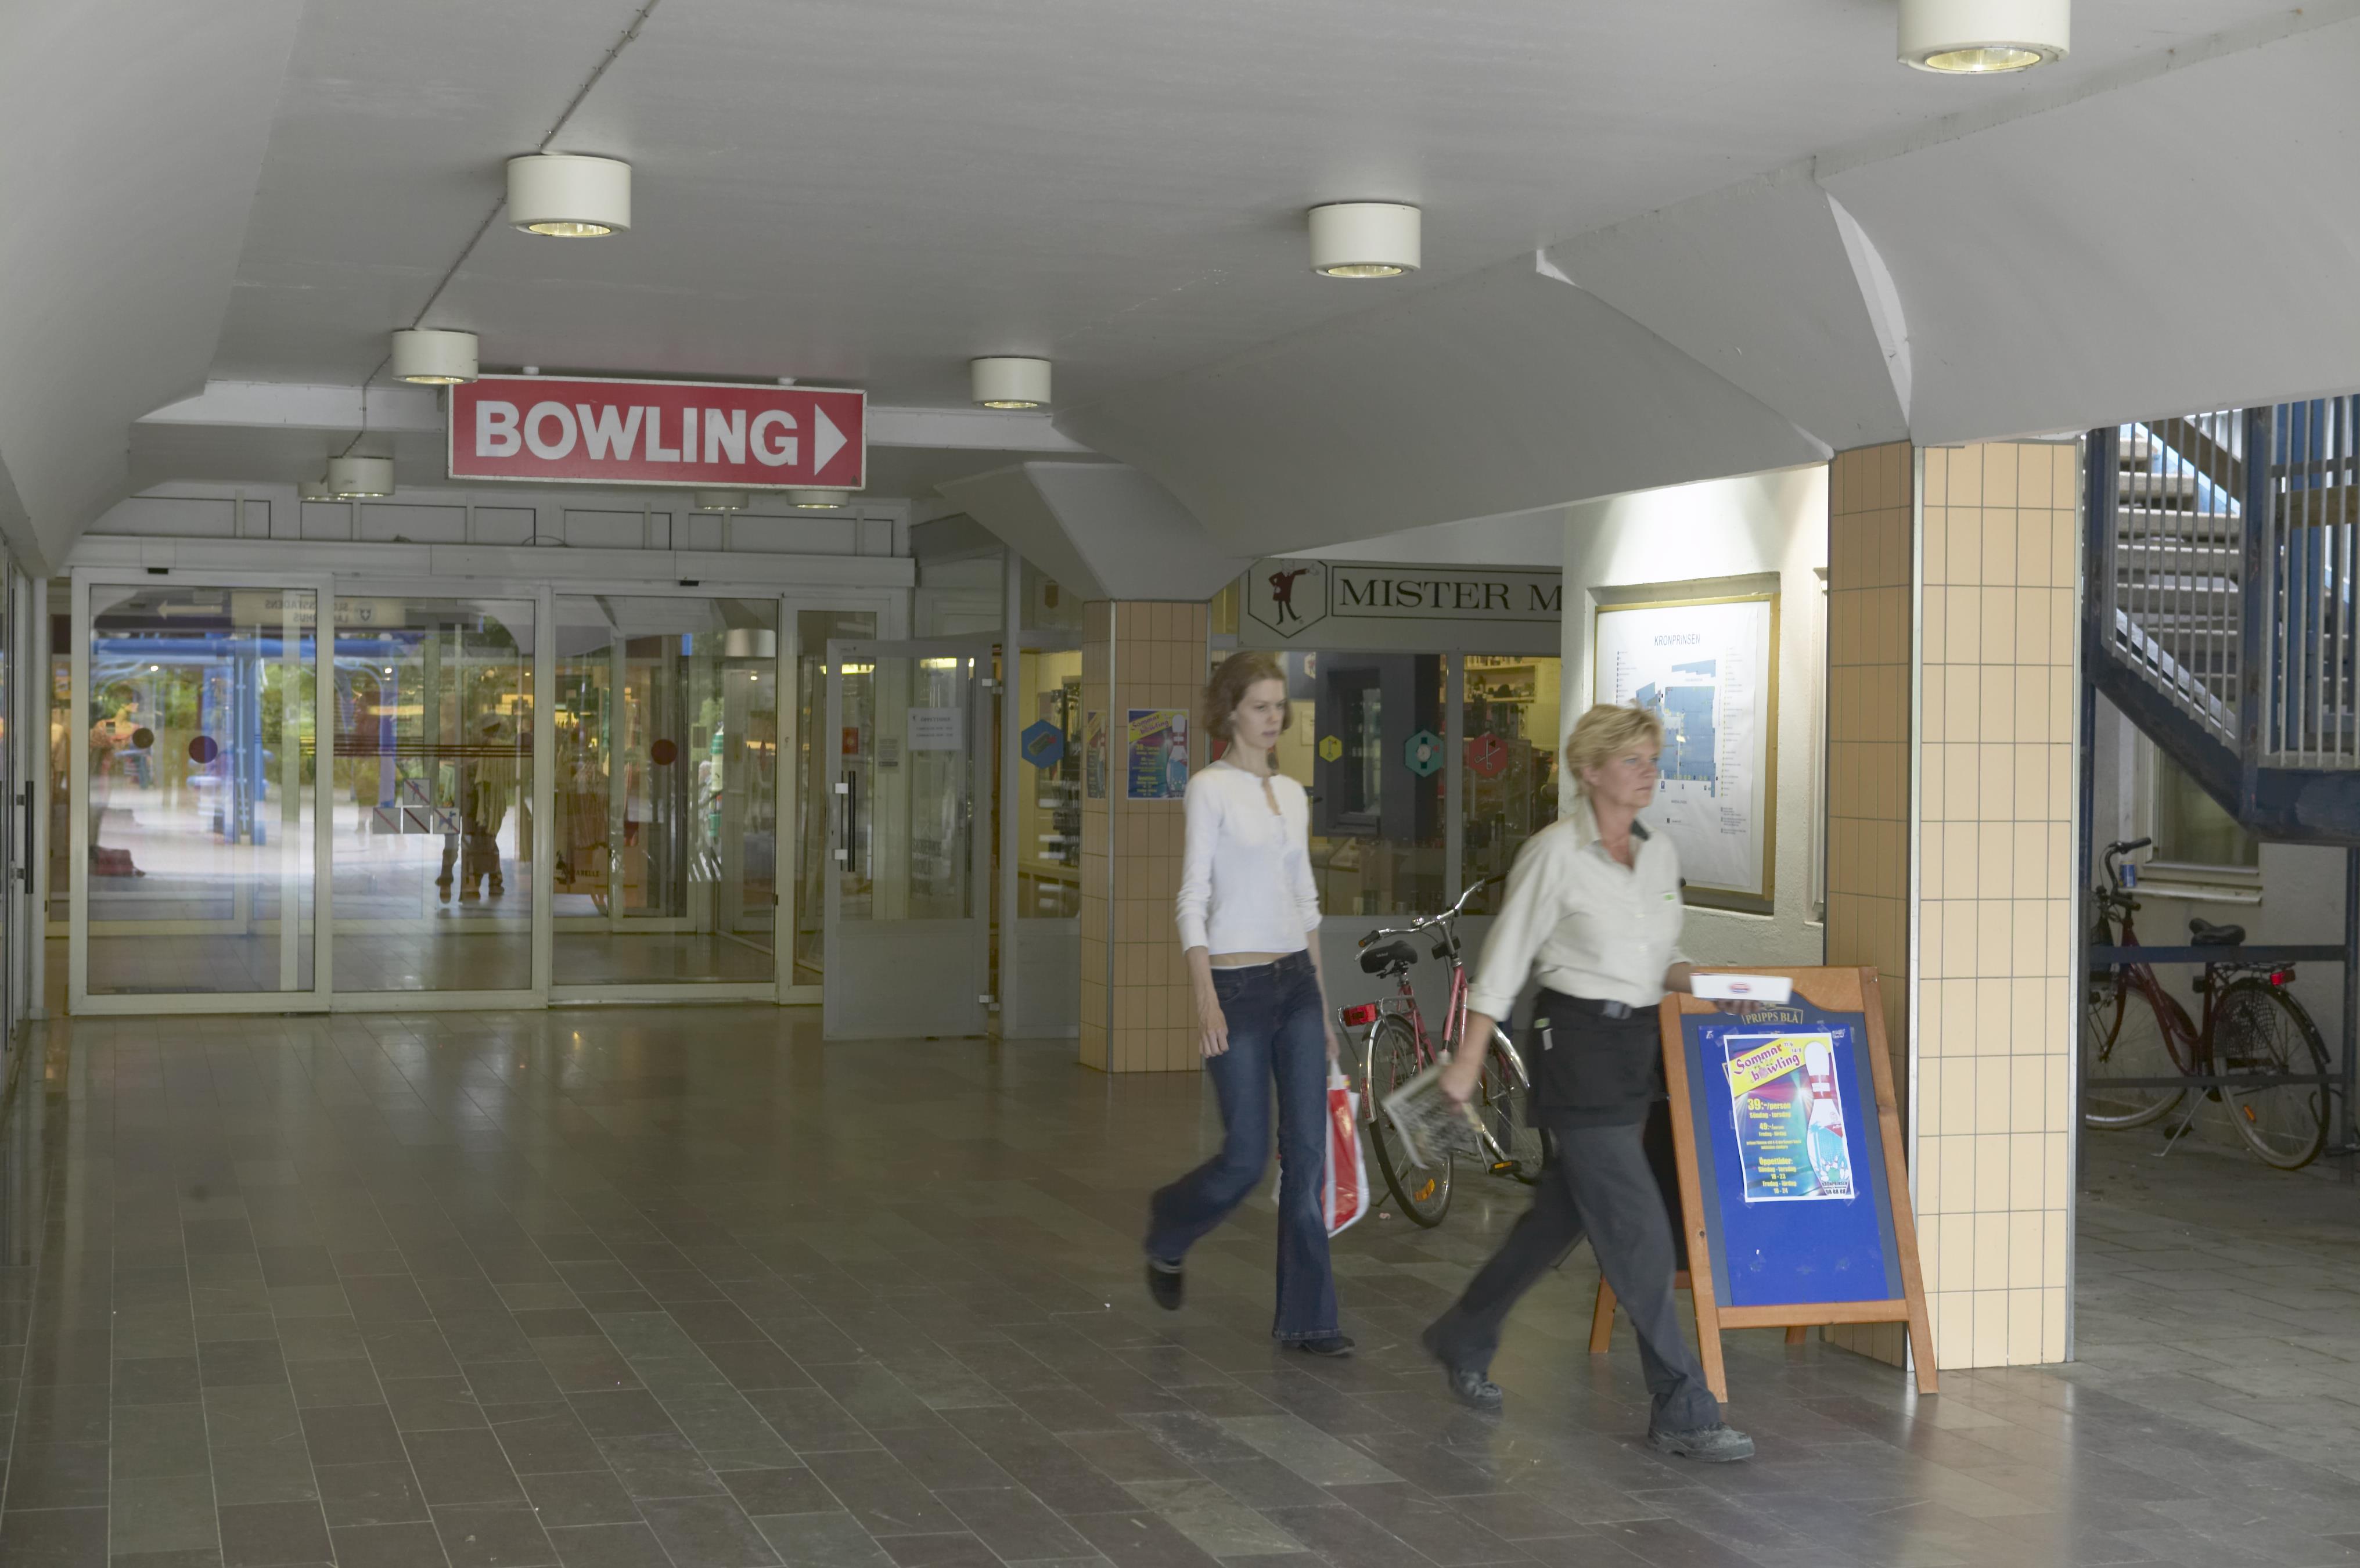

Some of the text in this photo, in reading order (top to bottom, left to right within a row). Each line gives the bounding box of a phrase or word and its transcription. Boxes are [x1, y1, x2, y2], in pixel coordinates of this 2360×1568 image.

[476, 401, 798, 466] BOWLING
[1339, 578, 1510, 610] MISTER
[1654, 634, 1700, 646] KRONPRINSEN
[1745, 1011, 1799, 1024] PRIPPS BLÅ
[1733, 1043, 1782, 1074] Sommar
[1751, 1055, 1800, 1082] bowling
